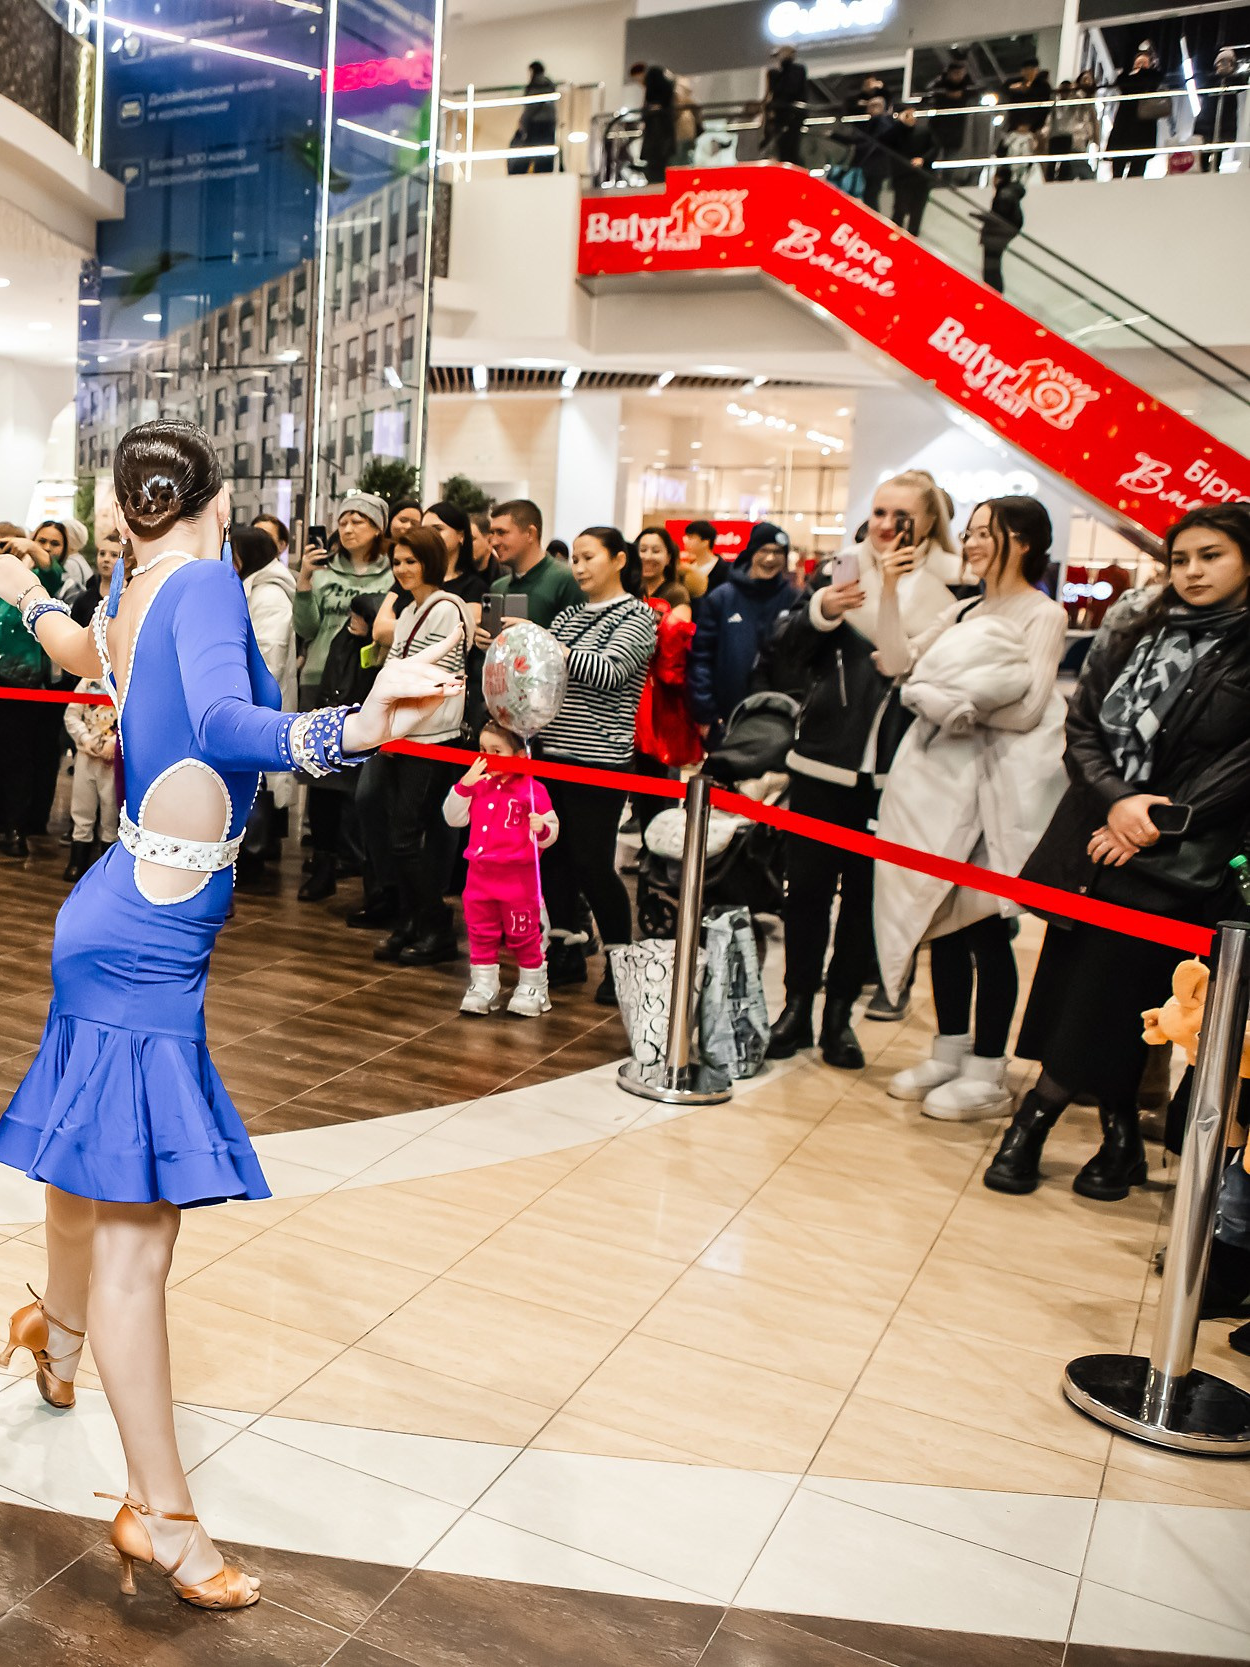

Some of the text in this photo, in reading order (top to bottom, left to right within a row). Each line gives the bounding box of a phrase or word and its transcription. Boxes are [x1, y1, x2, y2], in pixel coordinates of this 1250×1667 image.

[586, 212, 672, 252] Batyr
[830, 223, 893, 276] Бірге
[927, 316, 1018, 391] Batyr
